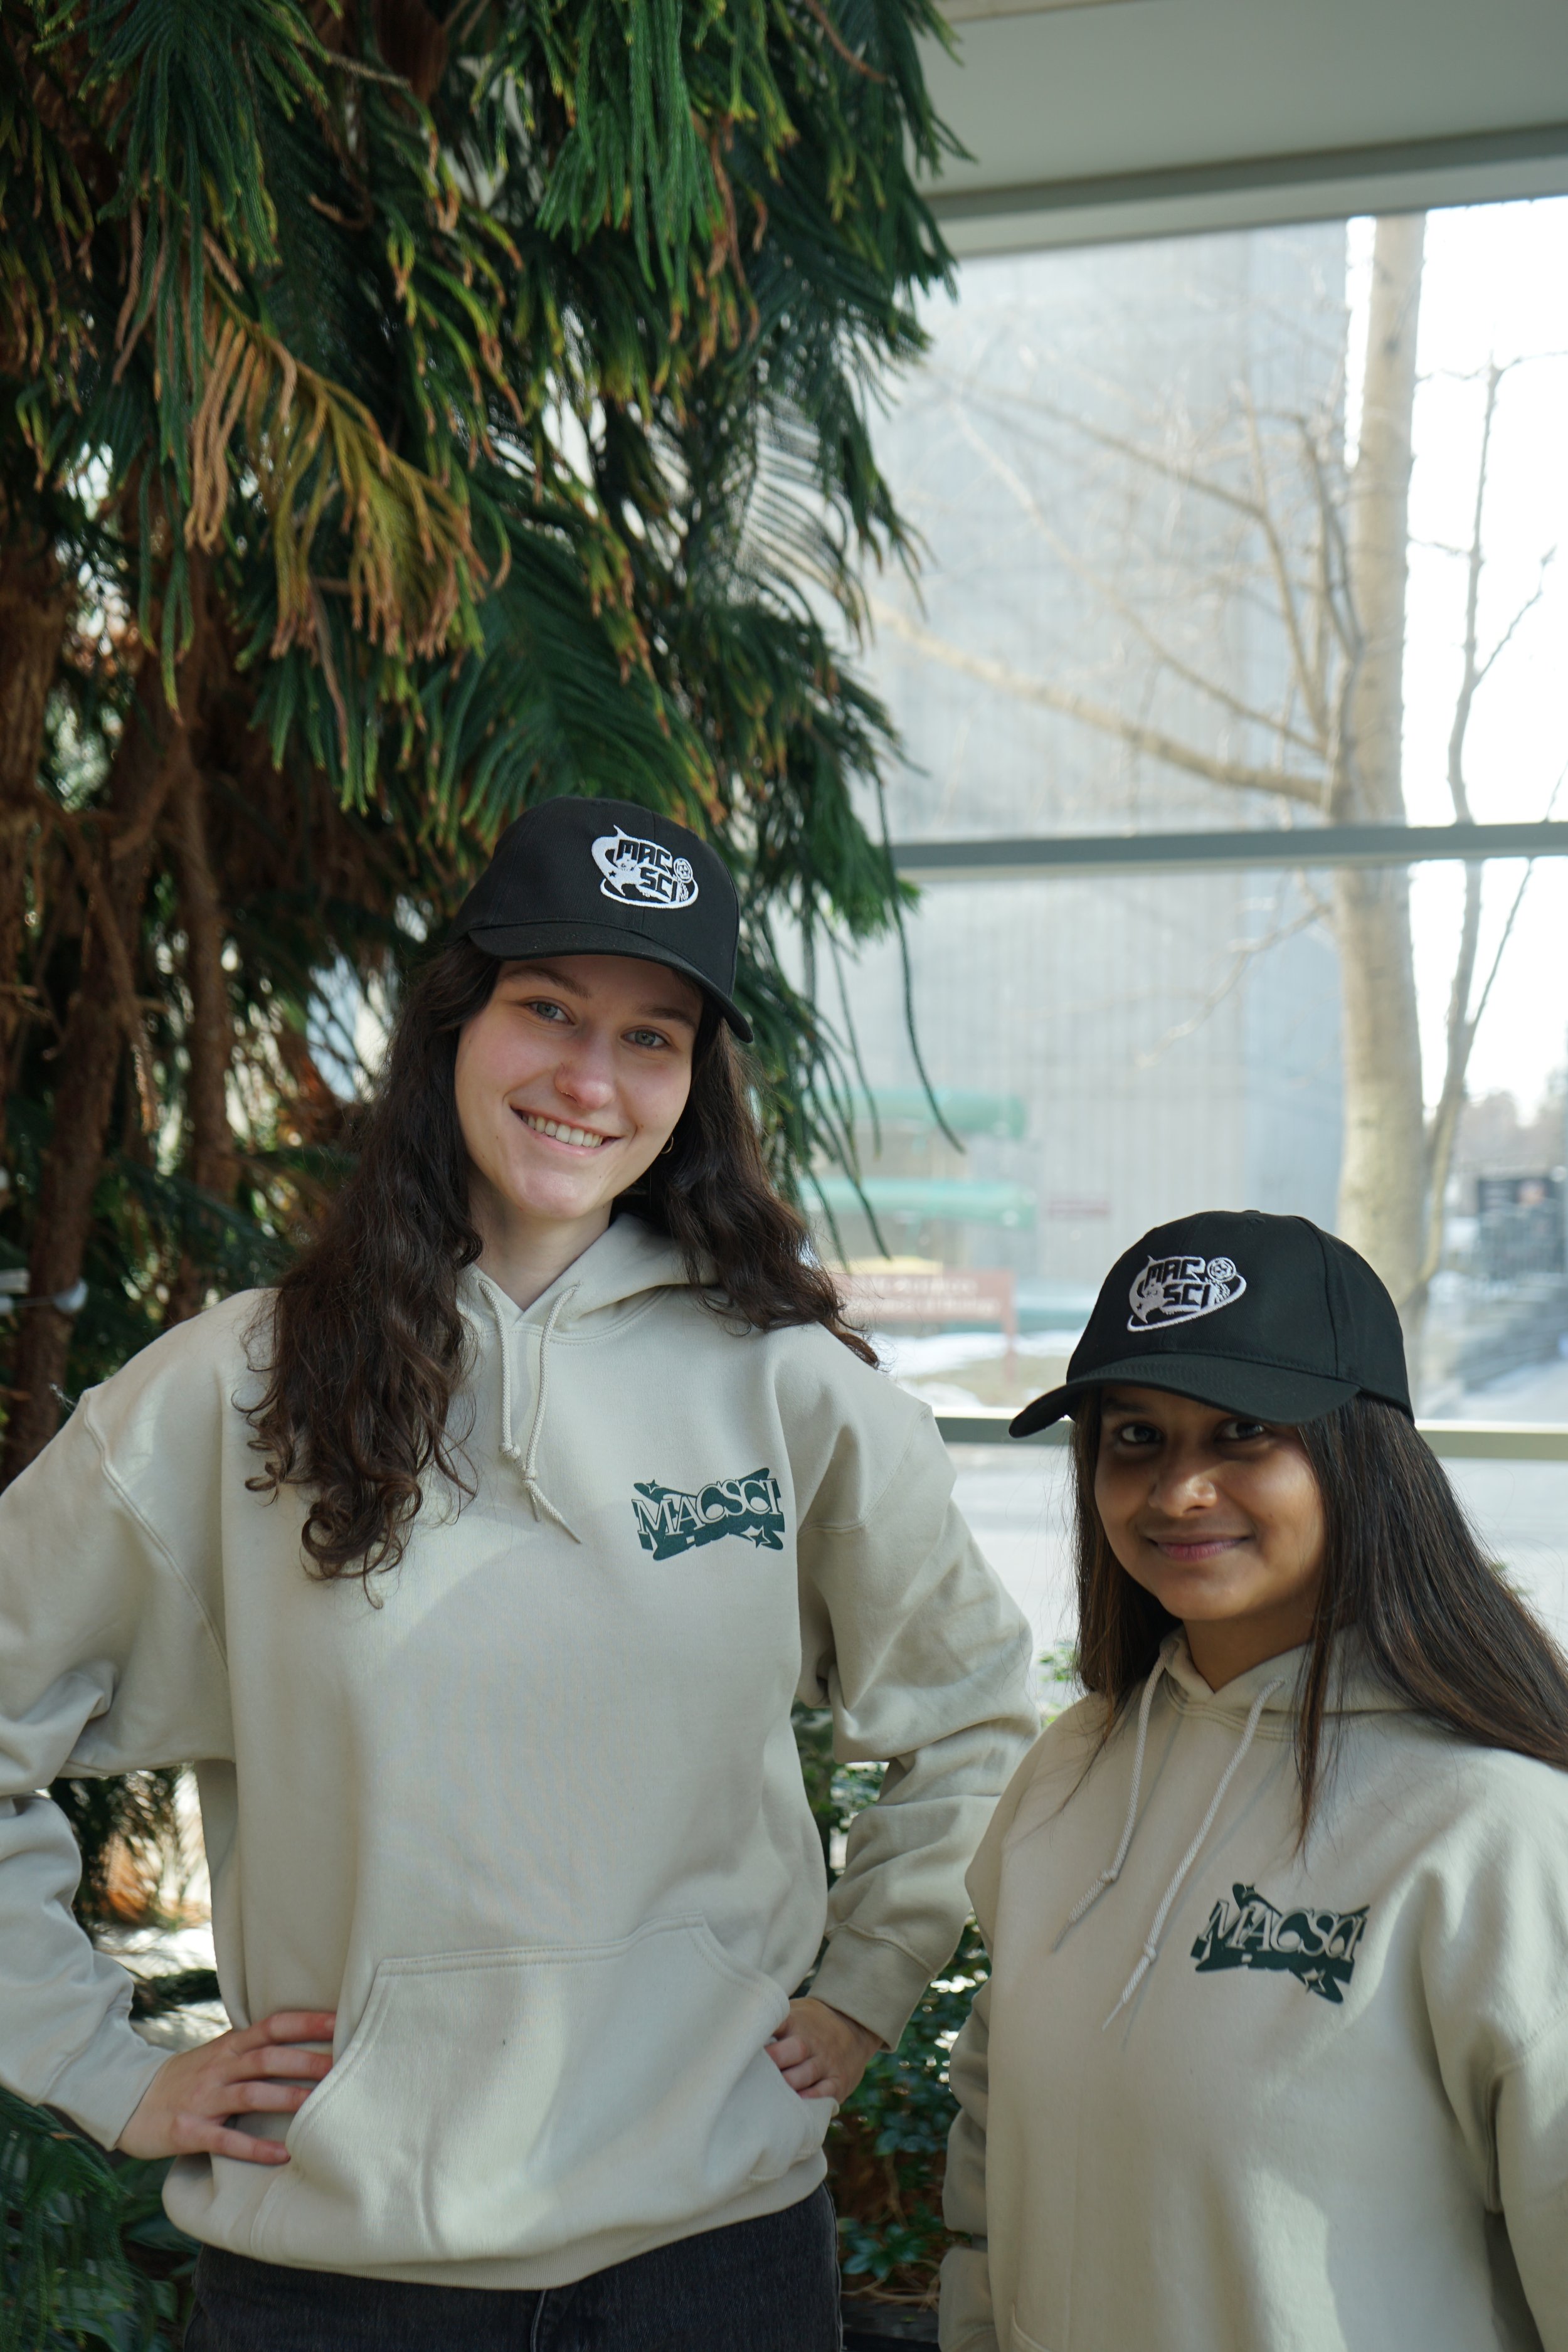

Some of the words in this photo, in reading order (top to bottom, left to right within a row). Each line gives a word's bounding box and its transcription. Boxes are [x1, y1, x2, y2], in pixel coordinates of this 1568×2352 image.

[617, 839, 671, 874] MAC
[638, 866, 677, 902] SCI
[1144, 1259, 1204, 1289] MAC
[1162, 1283, 1212, 1310] SCI
[631, 1478, 783, 1535] MACSCI
[1199, 1899, 1367, 1963] MACSCI
